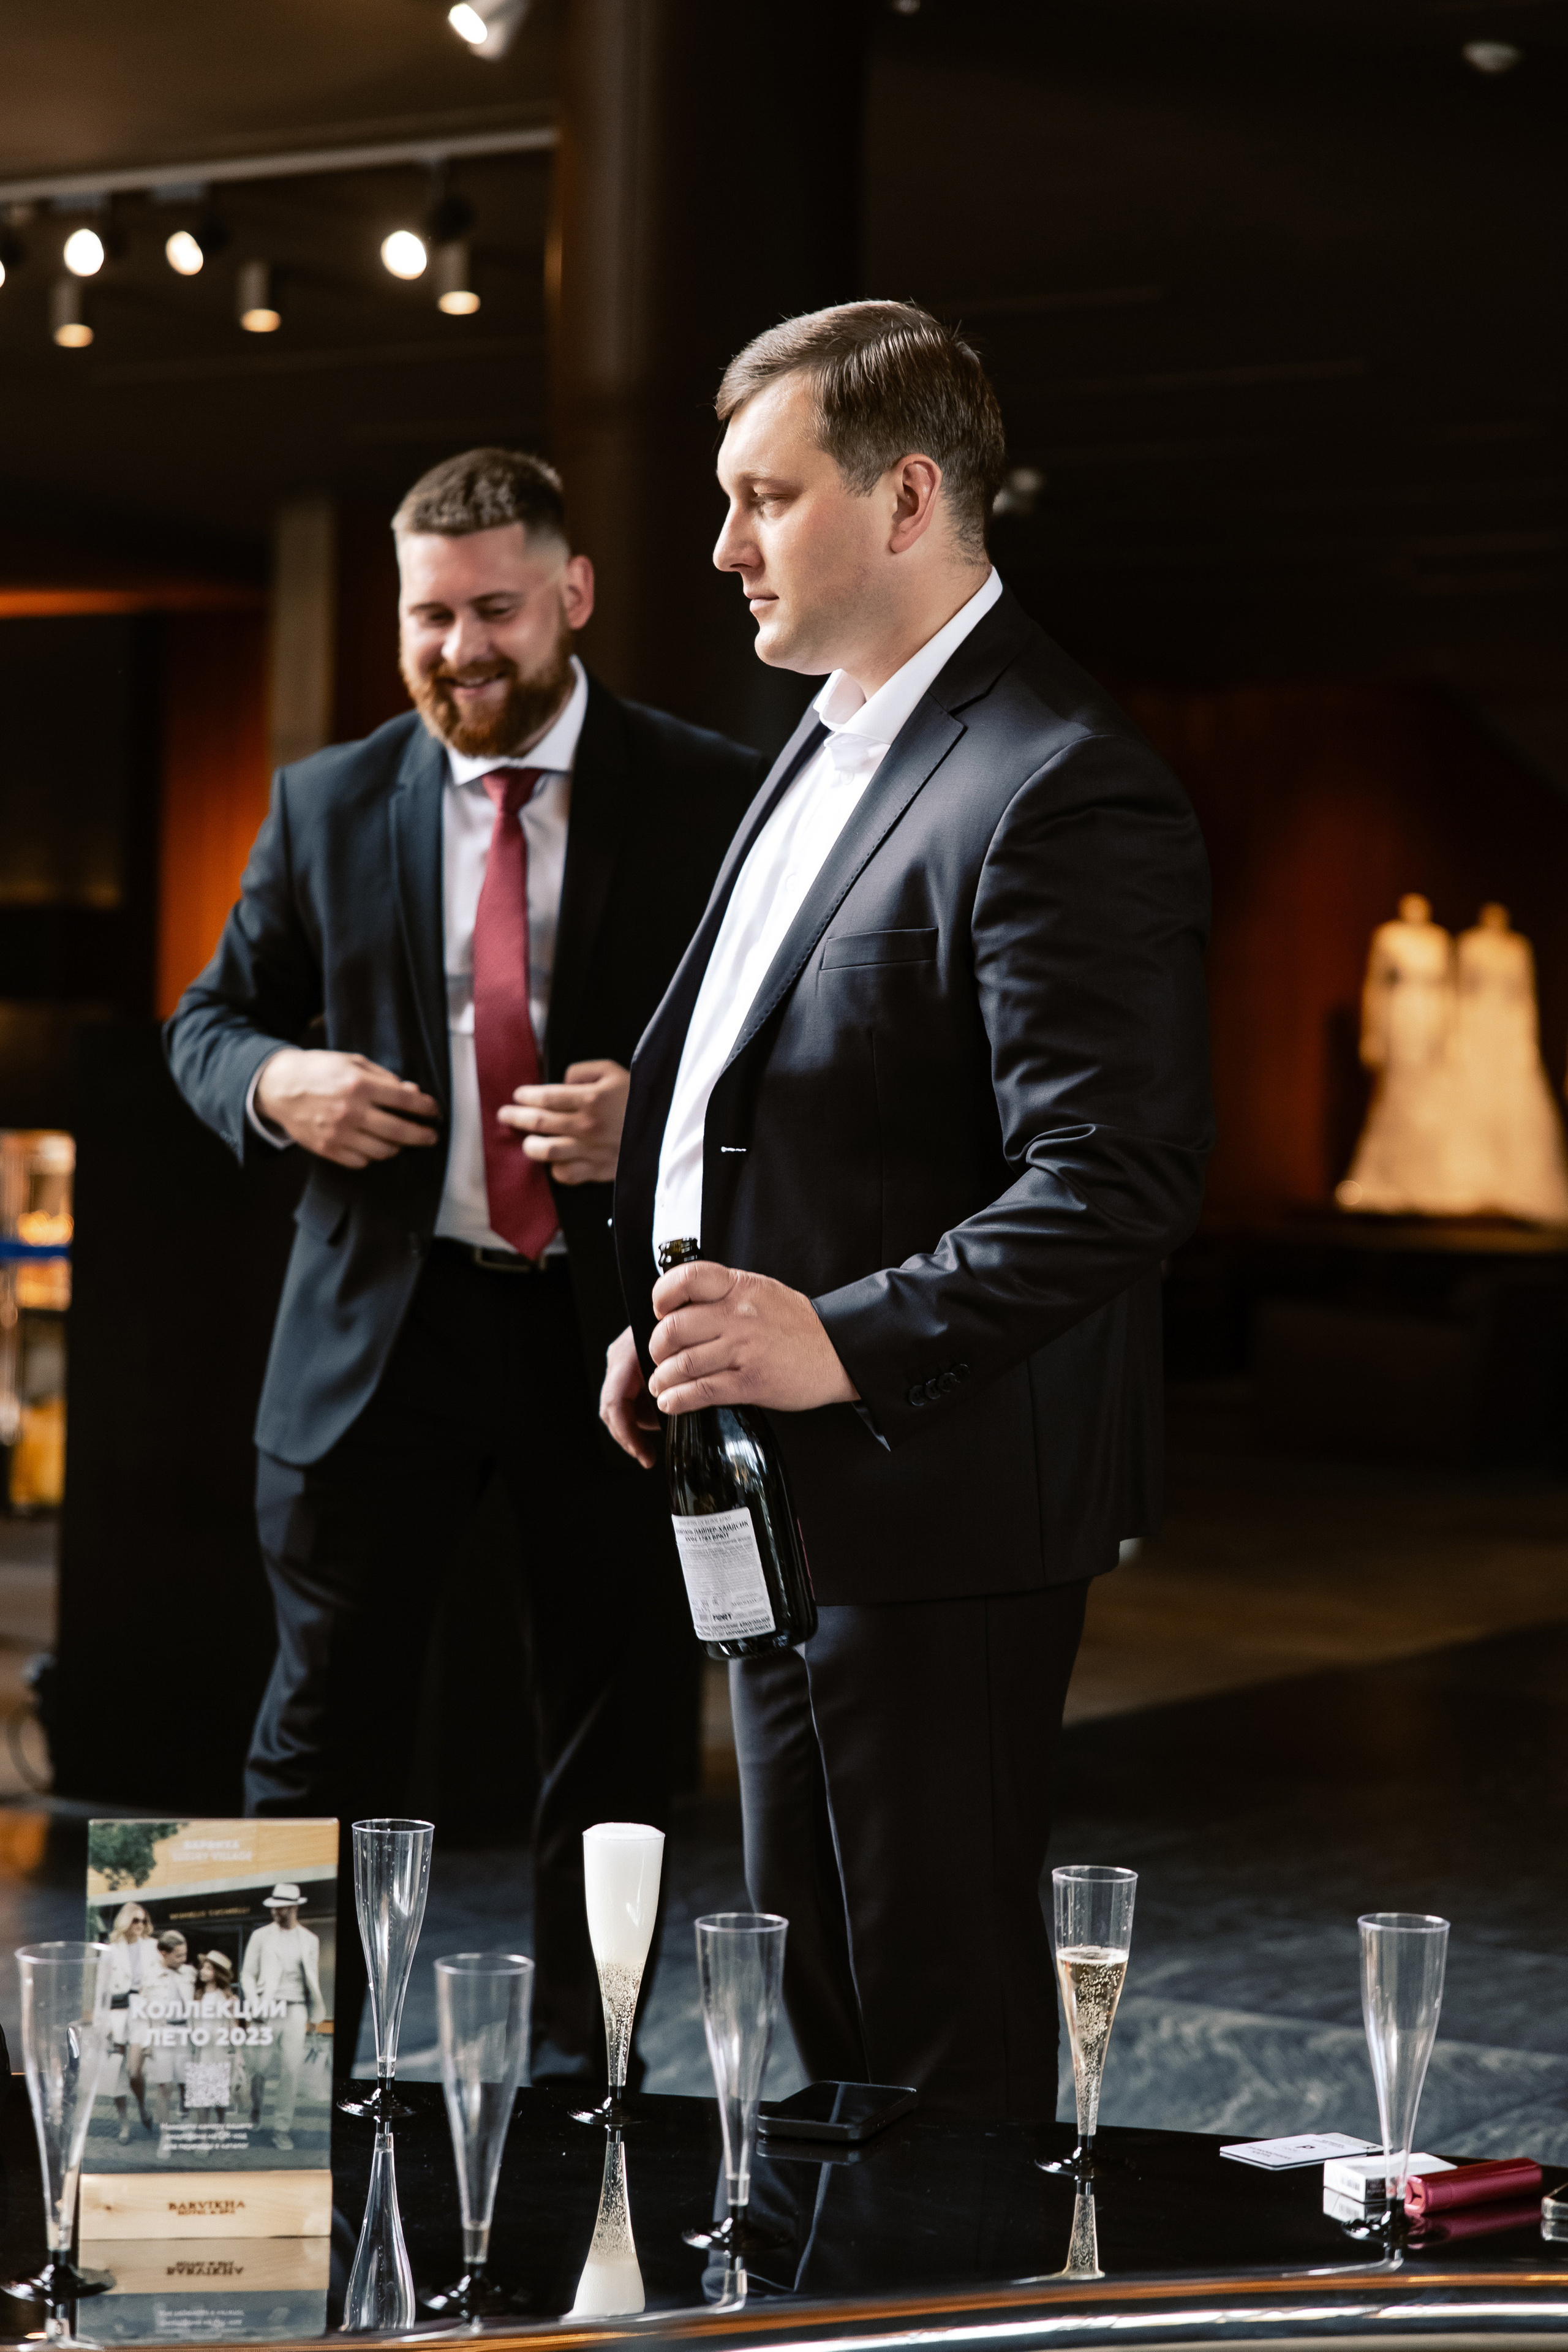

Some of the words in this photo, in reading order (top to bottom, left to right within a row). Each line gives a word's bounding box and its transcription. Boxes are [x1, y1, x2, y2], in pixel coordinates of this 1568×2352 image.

[130, 1999, 287, 2021] КОЛЛЕКЦИИ
[141, 2027, 209, 2047] ЛЕТО
[168, 2200, 245, 2211] BARVIKHA
